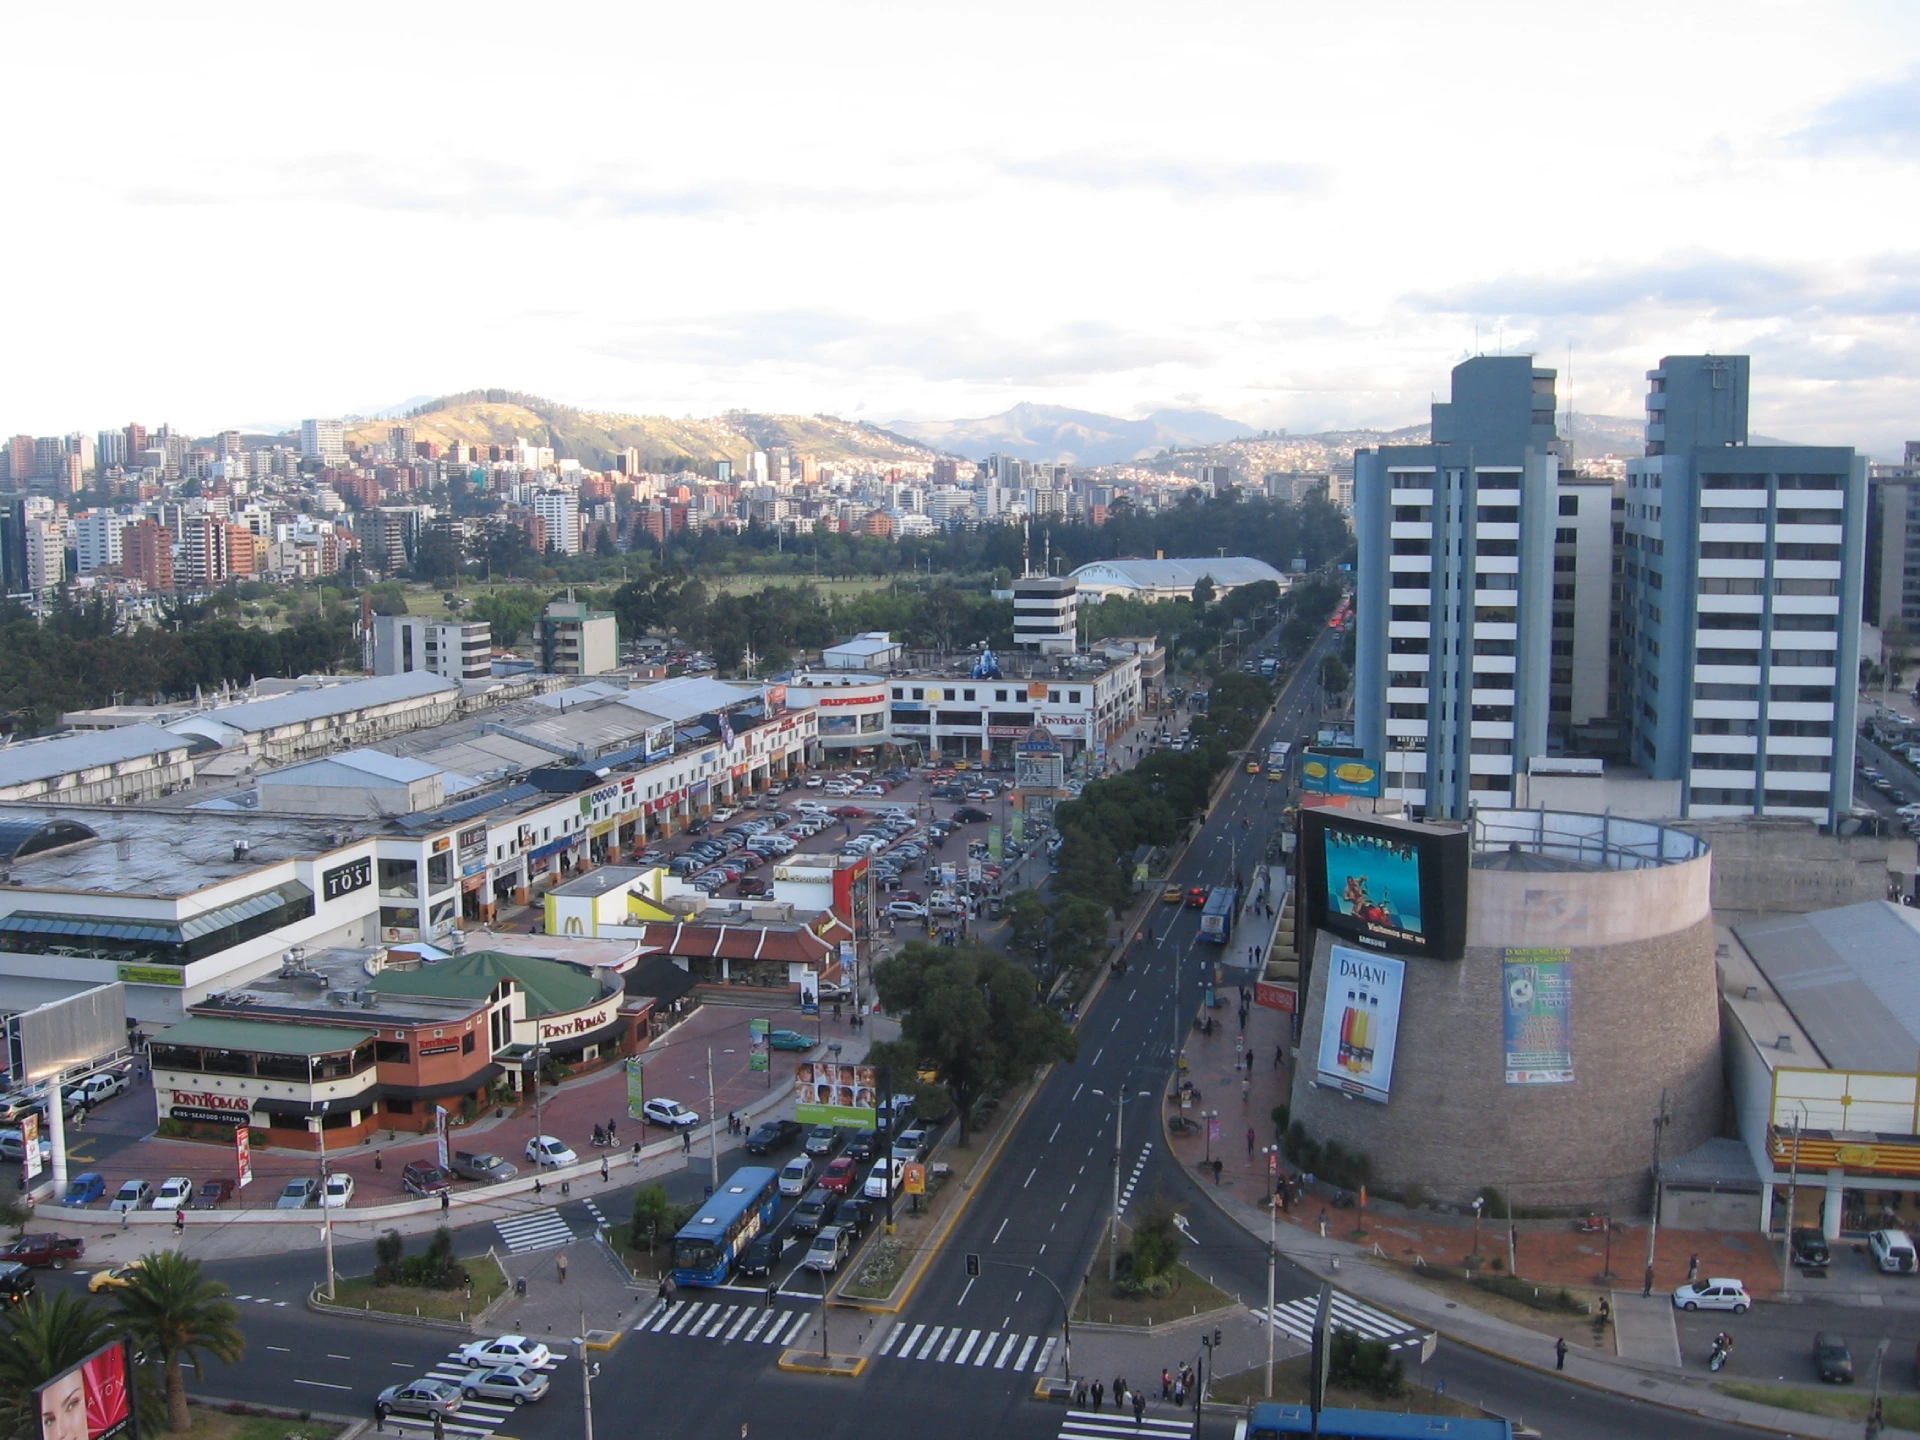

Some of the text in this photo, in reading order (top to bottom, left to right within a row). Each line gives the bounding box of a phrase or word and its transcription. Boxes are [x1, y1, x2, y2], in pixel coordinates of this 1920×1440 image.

[988, 727, 1014, 735] BURGER
[1340, 959, 1386, 985] DASANI
[540, 1010, 607, 1038] TONY ROMA'S
[169, 1088, 204, 1105] TONY
[191, 1111, 218, 1120] SEAFOOD
